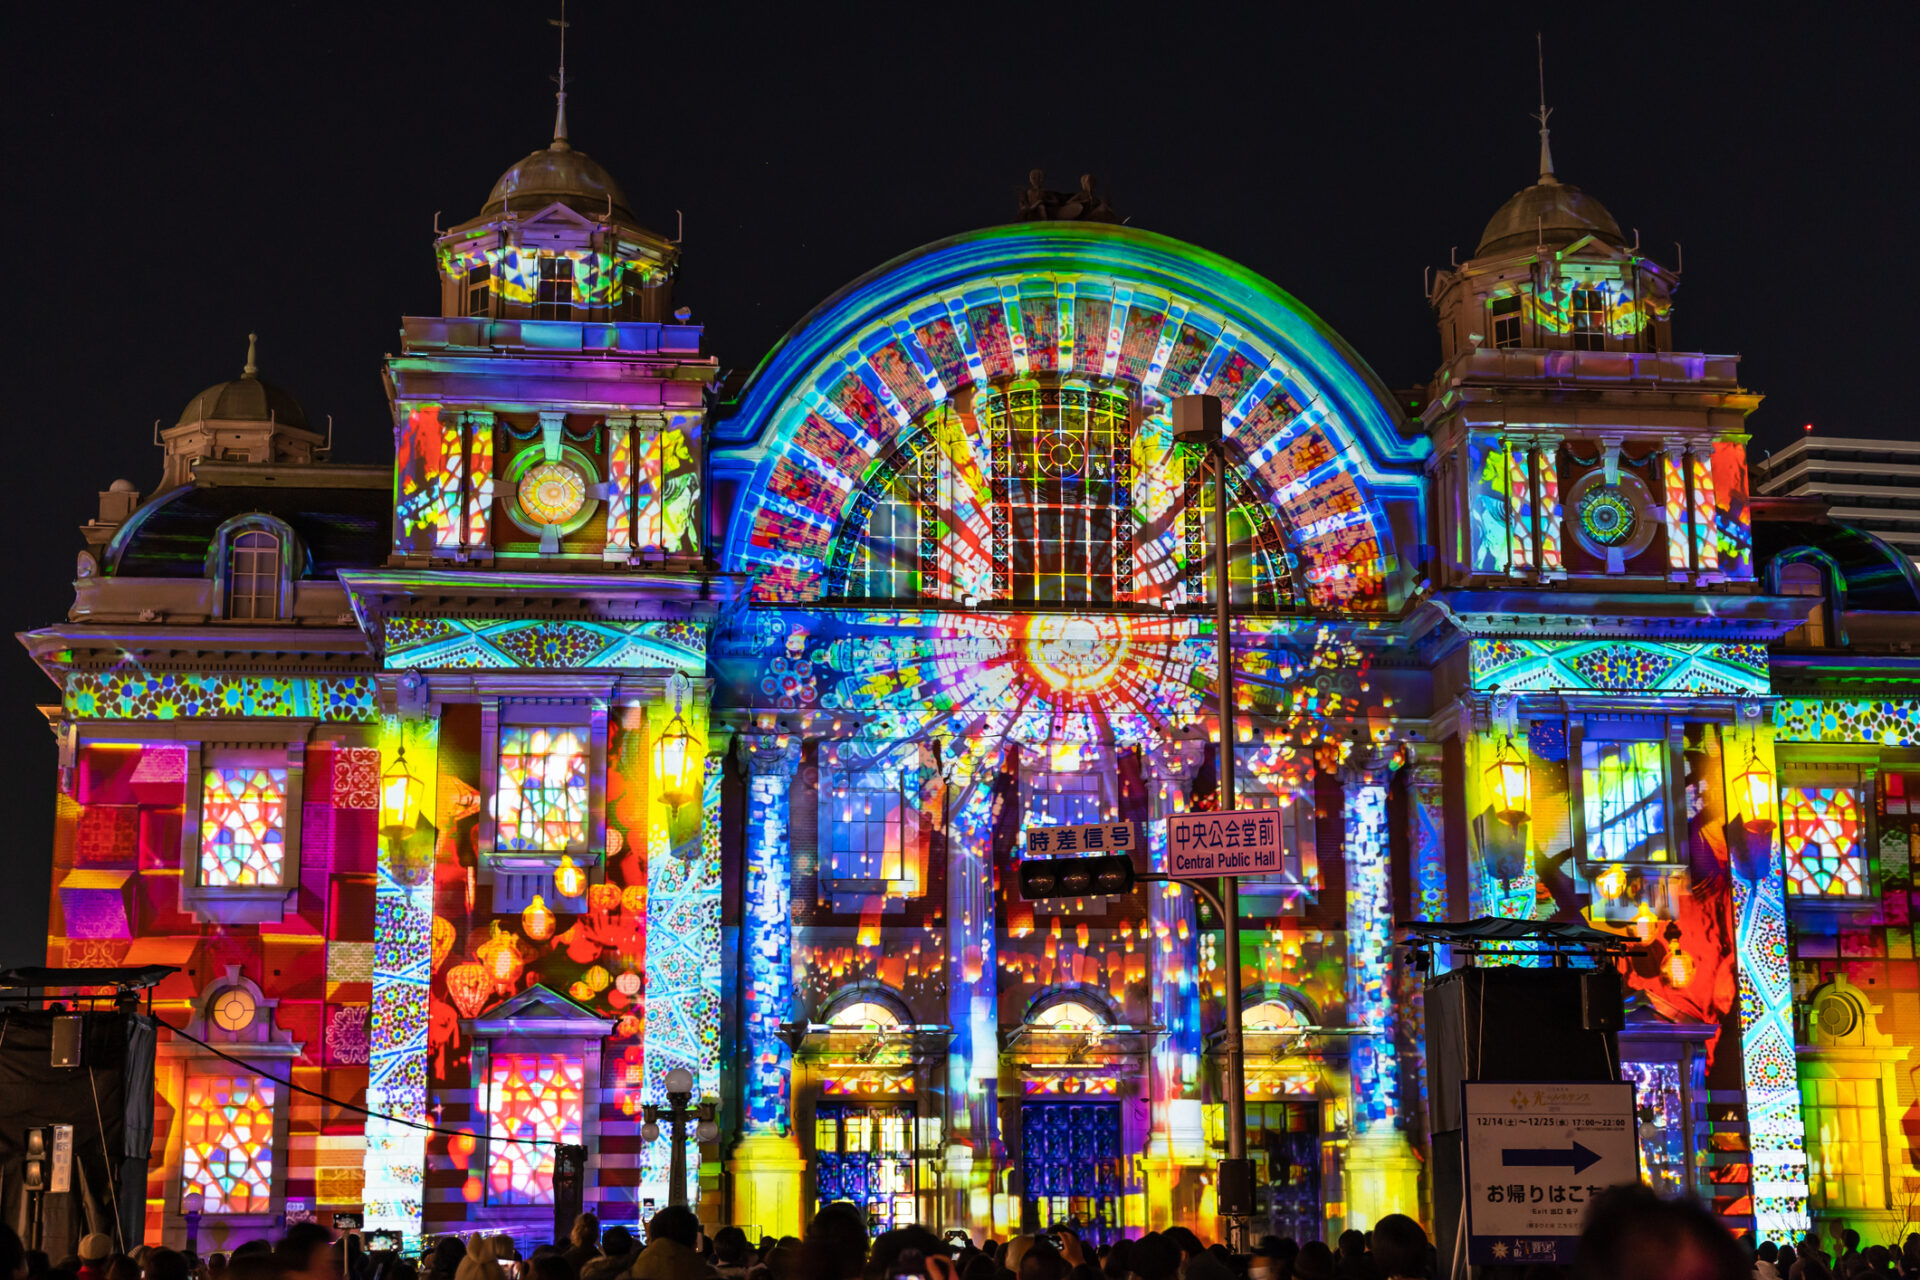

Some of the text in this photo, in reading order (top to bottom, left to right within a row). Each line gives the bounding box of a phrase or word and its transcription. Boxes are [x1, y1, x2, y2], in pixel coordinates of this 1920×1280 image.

[1029, 826, 1131, 852] 時差信号
[1176, 816, 1274, 850] 中央公会堂前
[1176, 850, 1275, 870] Central Public Hall
